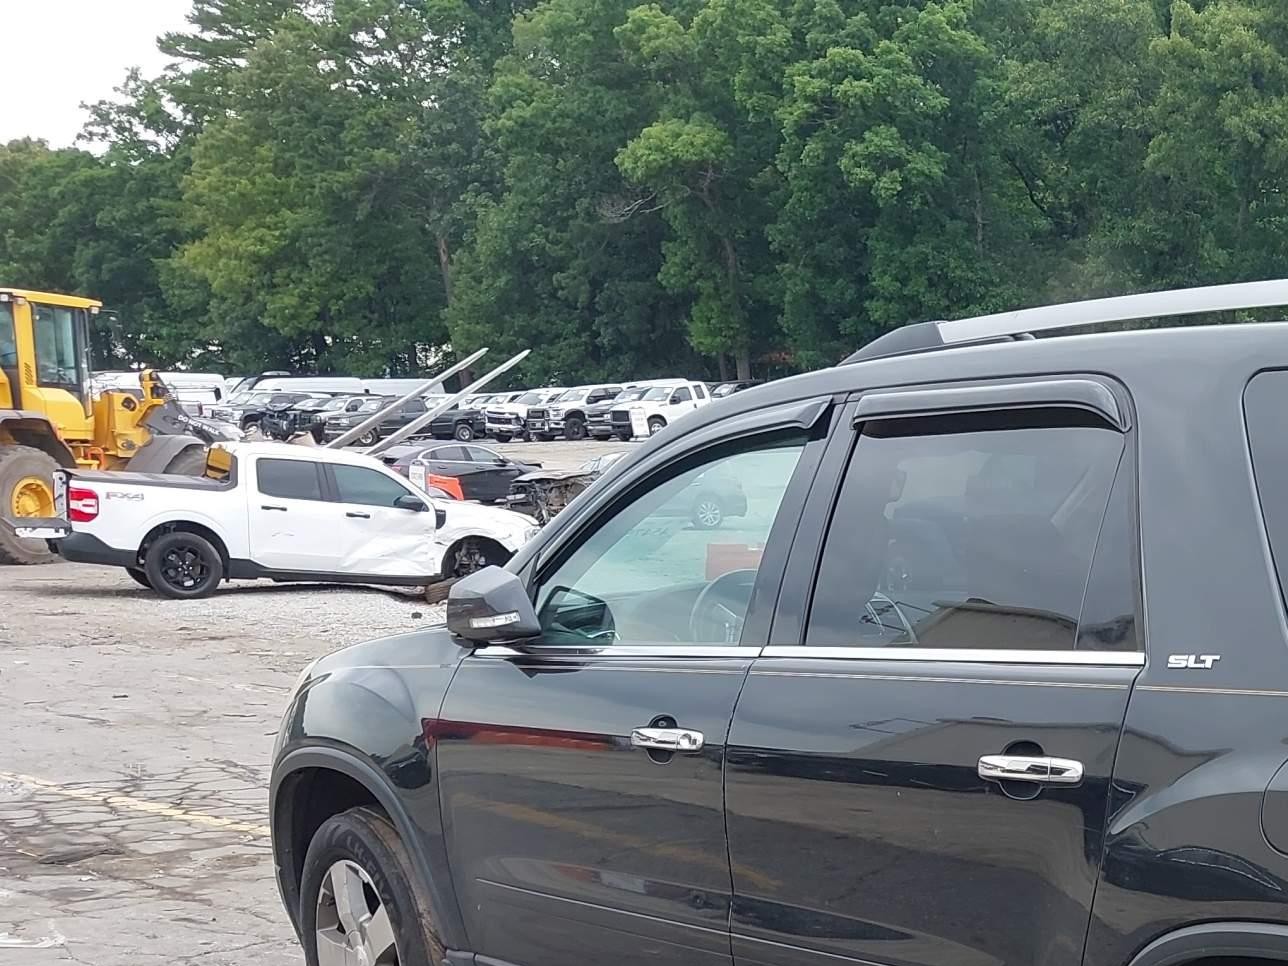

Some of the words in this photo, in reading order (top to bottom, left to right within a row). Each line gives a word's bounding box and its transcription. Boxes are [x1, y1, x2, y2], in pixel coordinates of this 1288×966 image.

[177, 414, 189, 423] DO
[105, 491, 145, 501] FX4
[1167, 654, 1221, 669] SLT
